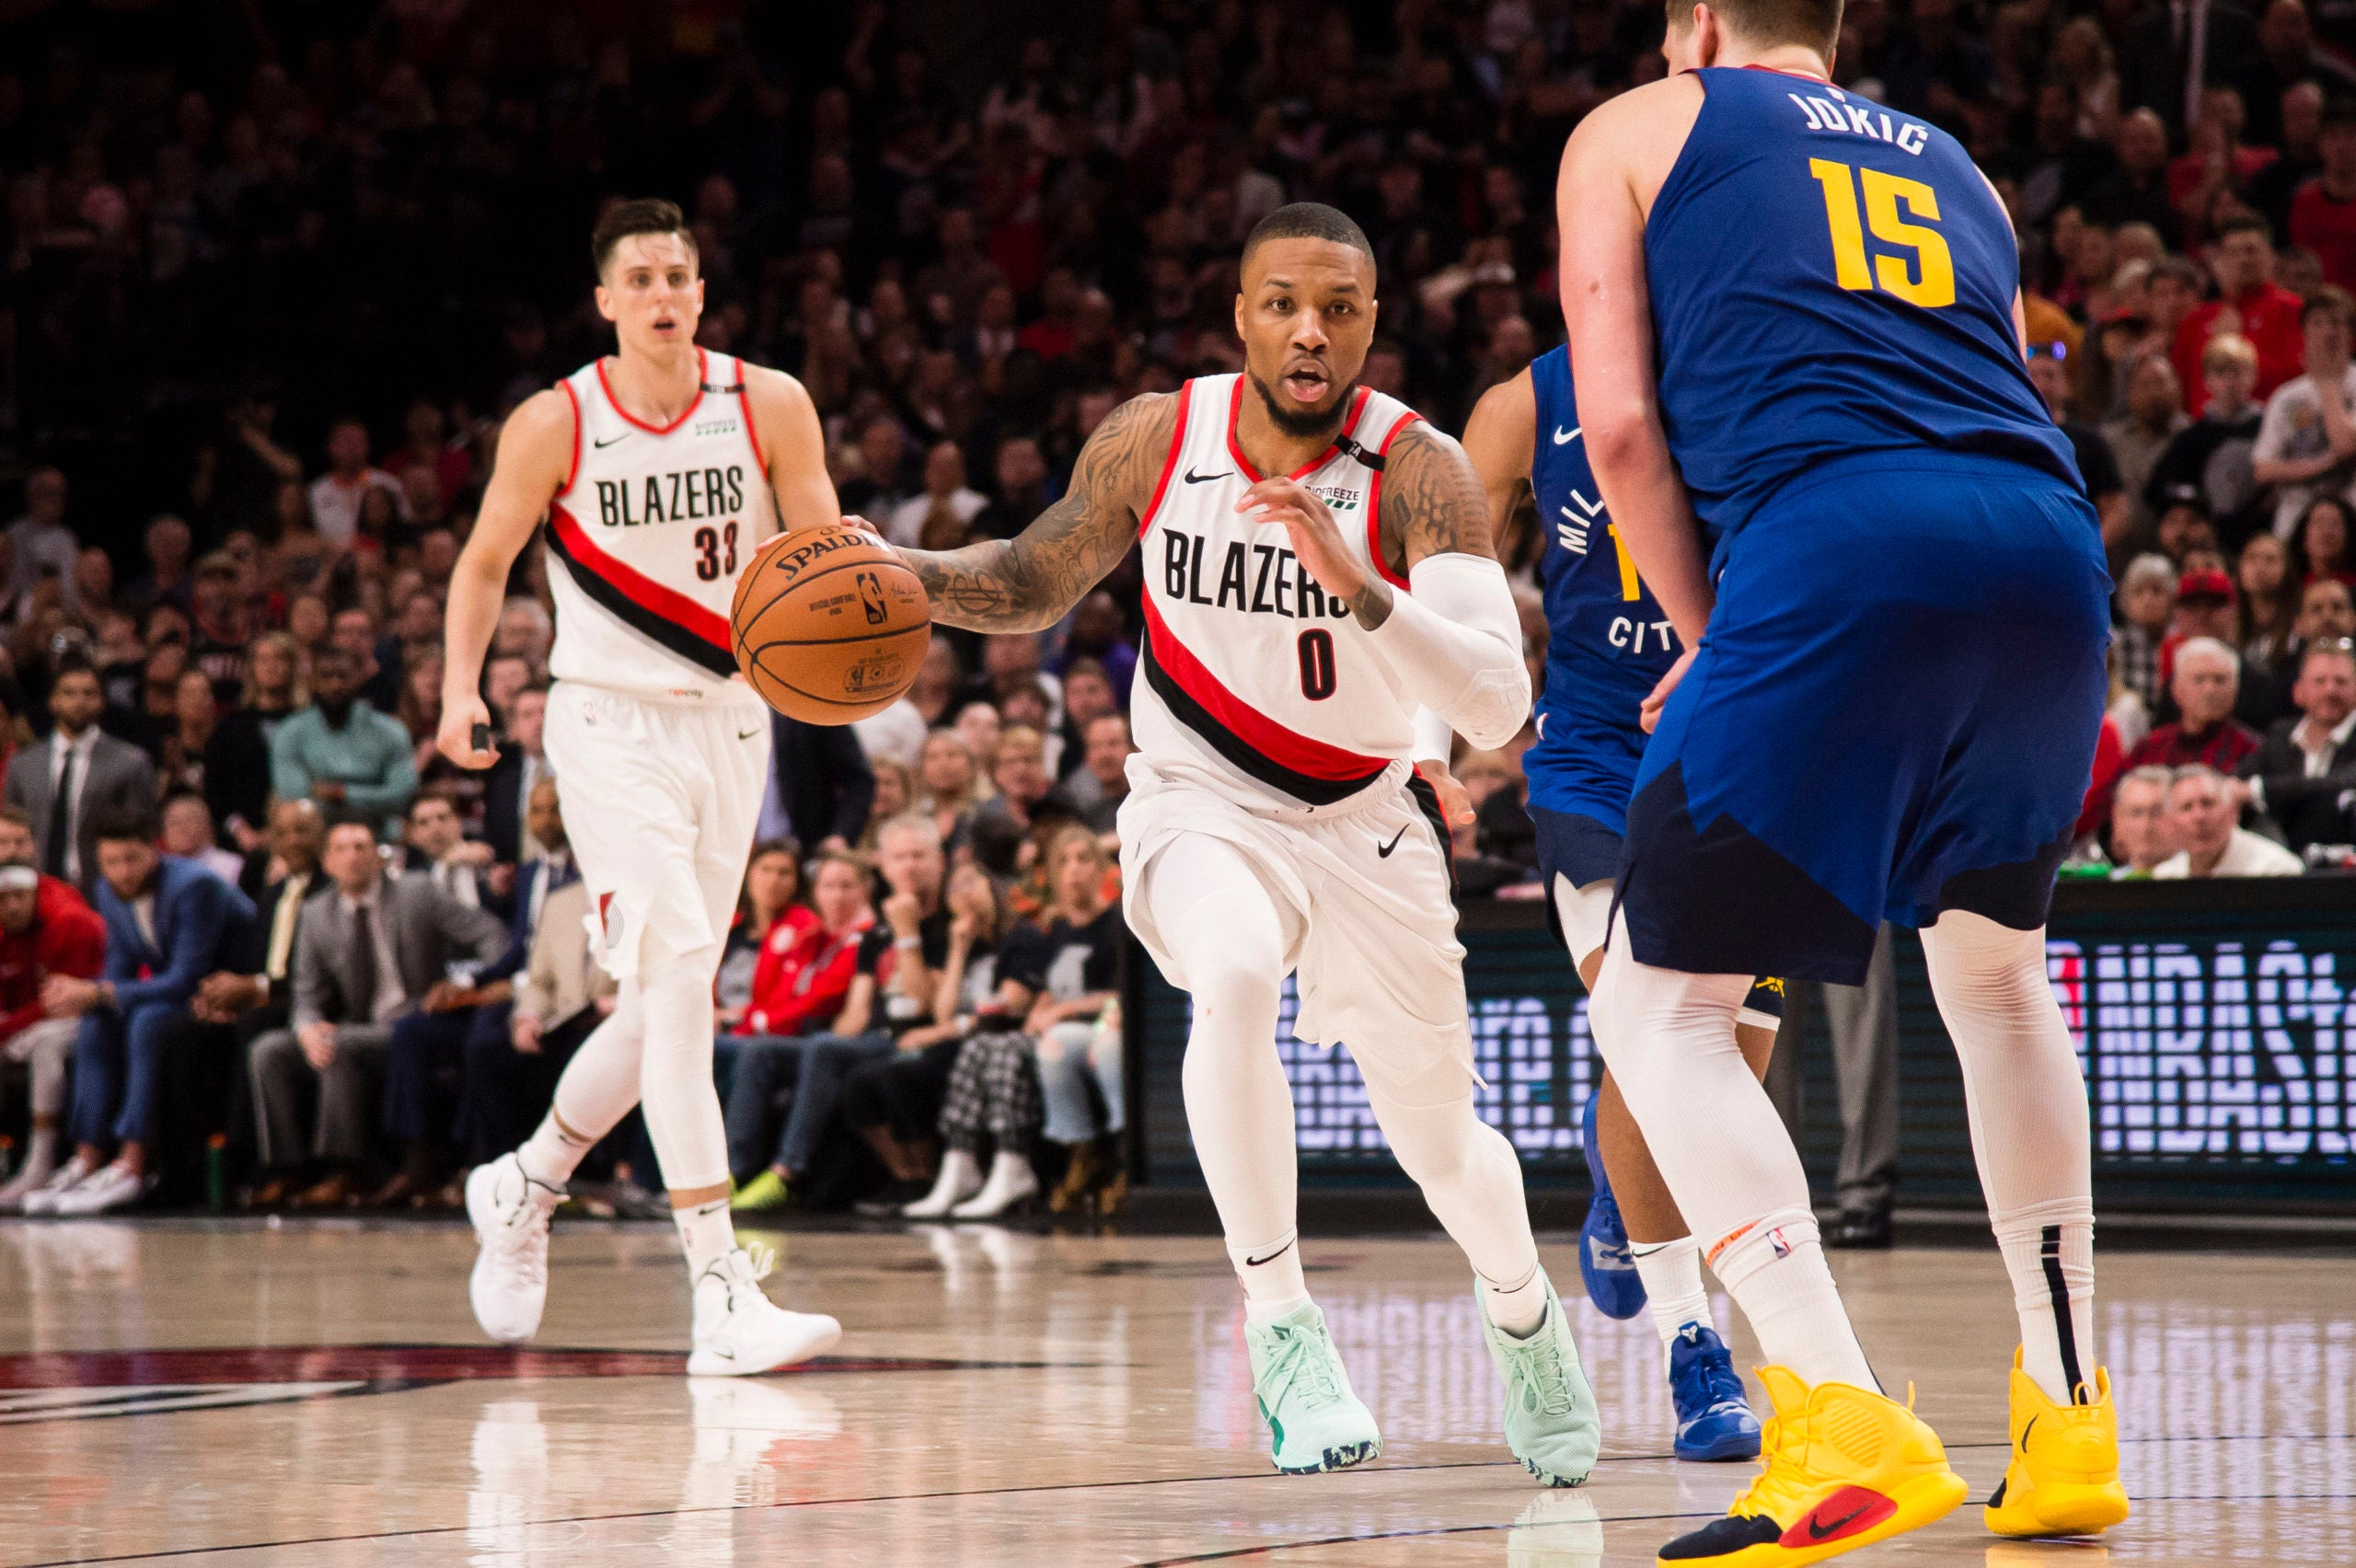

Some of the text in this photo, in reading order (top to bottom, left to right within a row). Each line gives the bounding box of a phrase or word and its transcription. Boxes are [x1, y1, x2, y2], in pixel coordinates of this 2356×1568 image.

[1808, 157, 1956, 308] 15
[595, 466, 744, 527] BLAZERS
[1557, 489, 1605, 555] MIL
[693, 520, 739, 582] 33
[1297, 628, 1337, 702] 0
[1608, 616, 1673, 654] CIT
